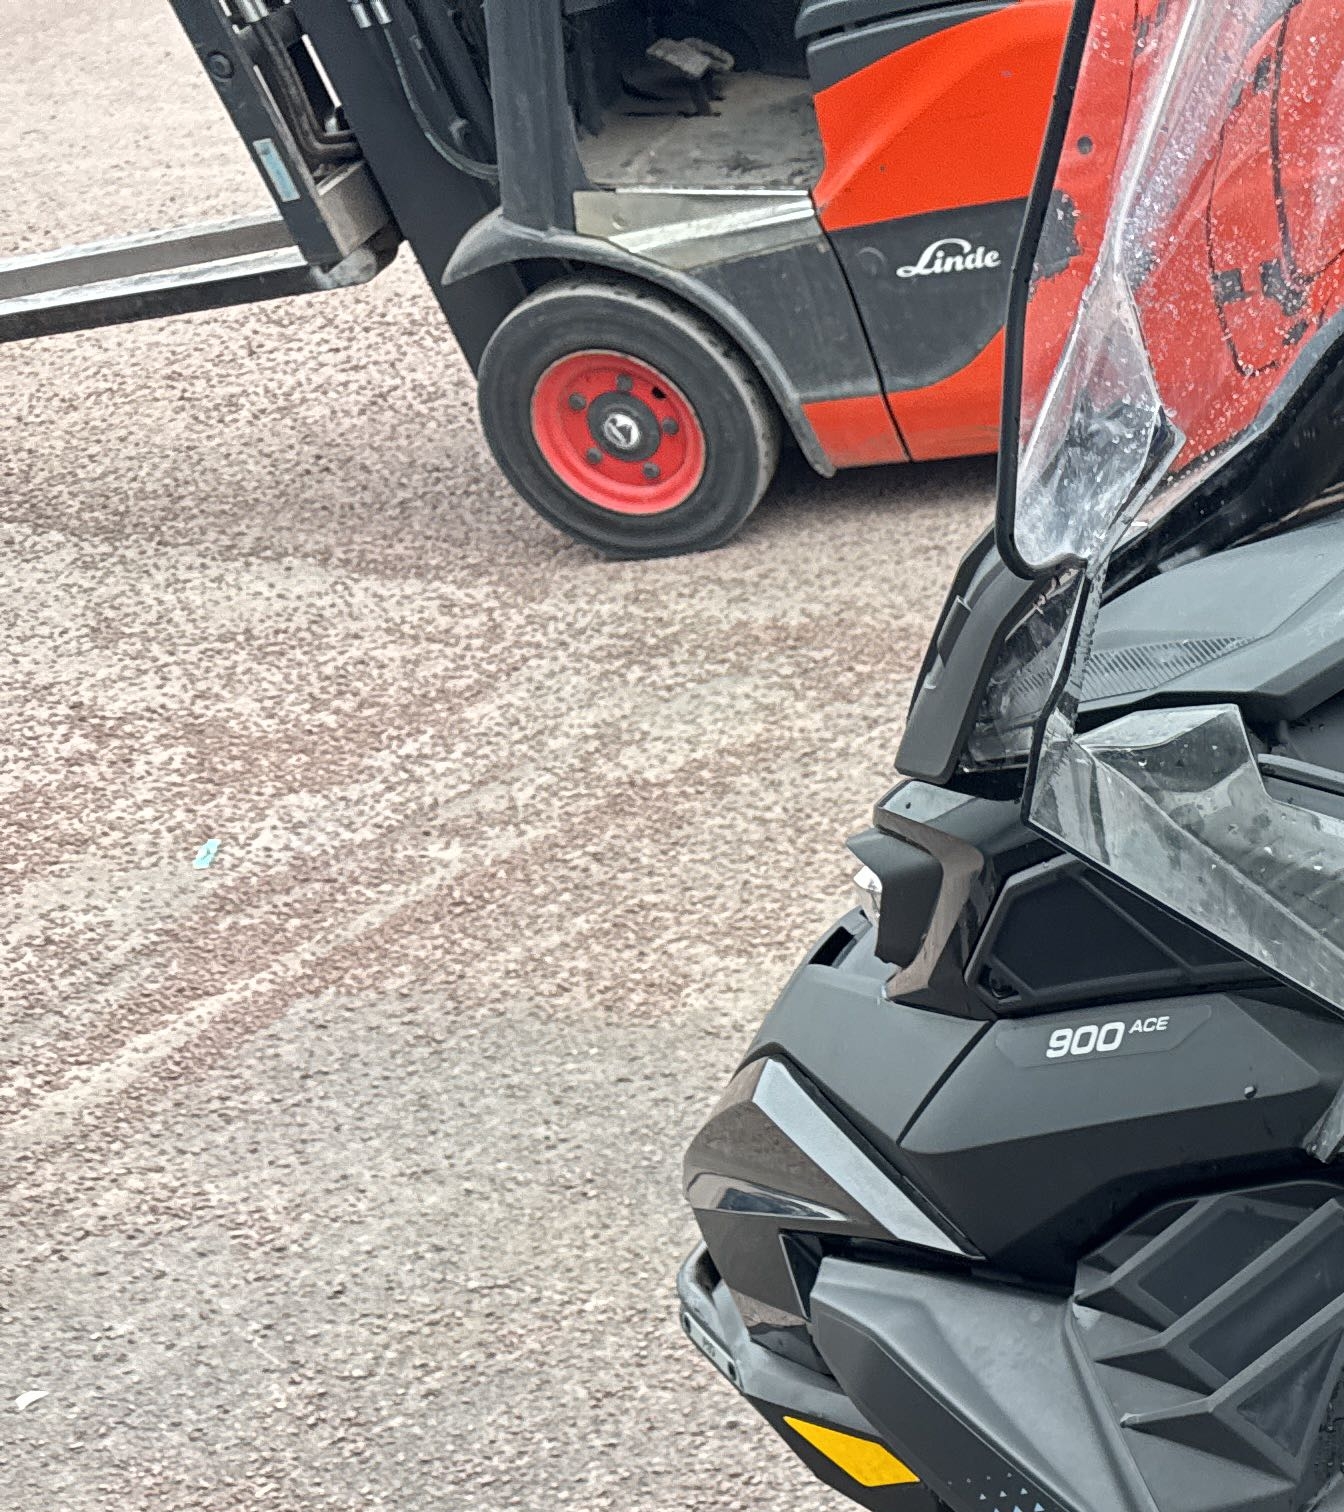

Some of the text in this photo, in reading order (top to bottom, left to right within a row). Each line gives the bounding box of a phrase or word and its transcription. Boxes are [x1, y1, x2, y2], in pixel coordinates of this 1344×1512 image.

[896, 237, 1002, 278] Linde
[1045, 1015, 1170, 1059] 900 ACE
